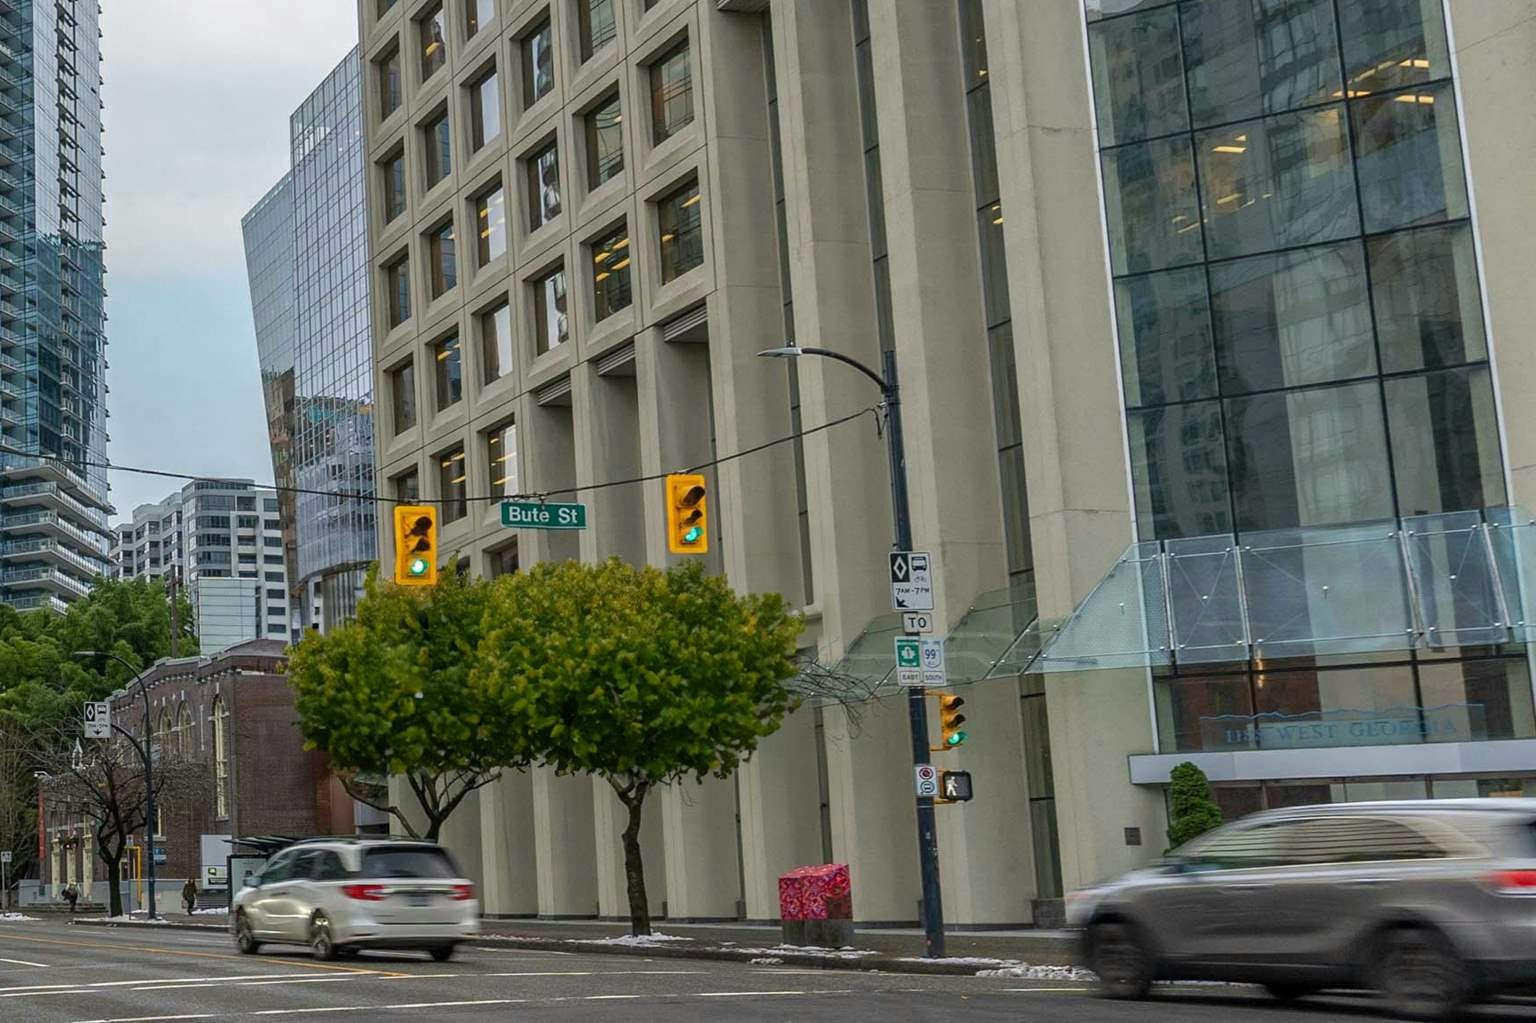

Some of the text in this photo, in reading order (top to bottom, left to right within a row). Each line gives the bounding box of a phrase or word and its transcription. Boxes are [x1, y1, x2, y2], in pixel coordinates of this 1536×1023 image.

[508, 506, 578, 524] Bute St
[908, 617, 927, 629] TO
[925, 649, 936, 660] 99
[1277, 725, 1337, 741] WEST
